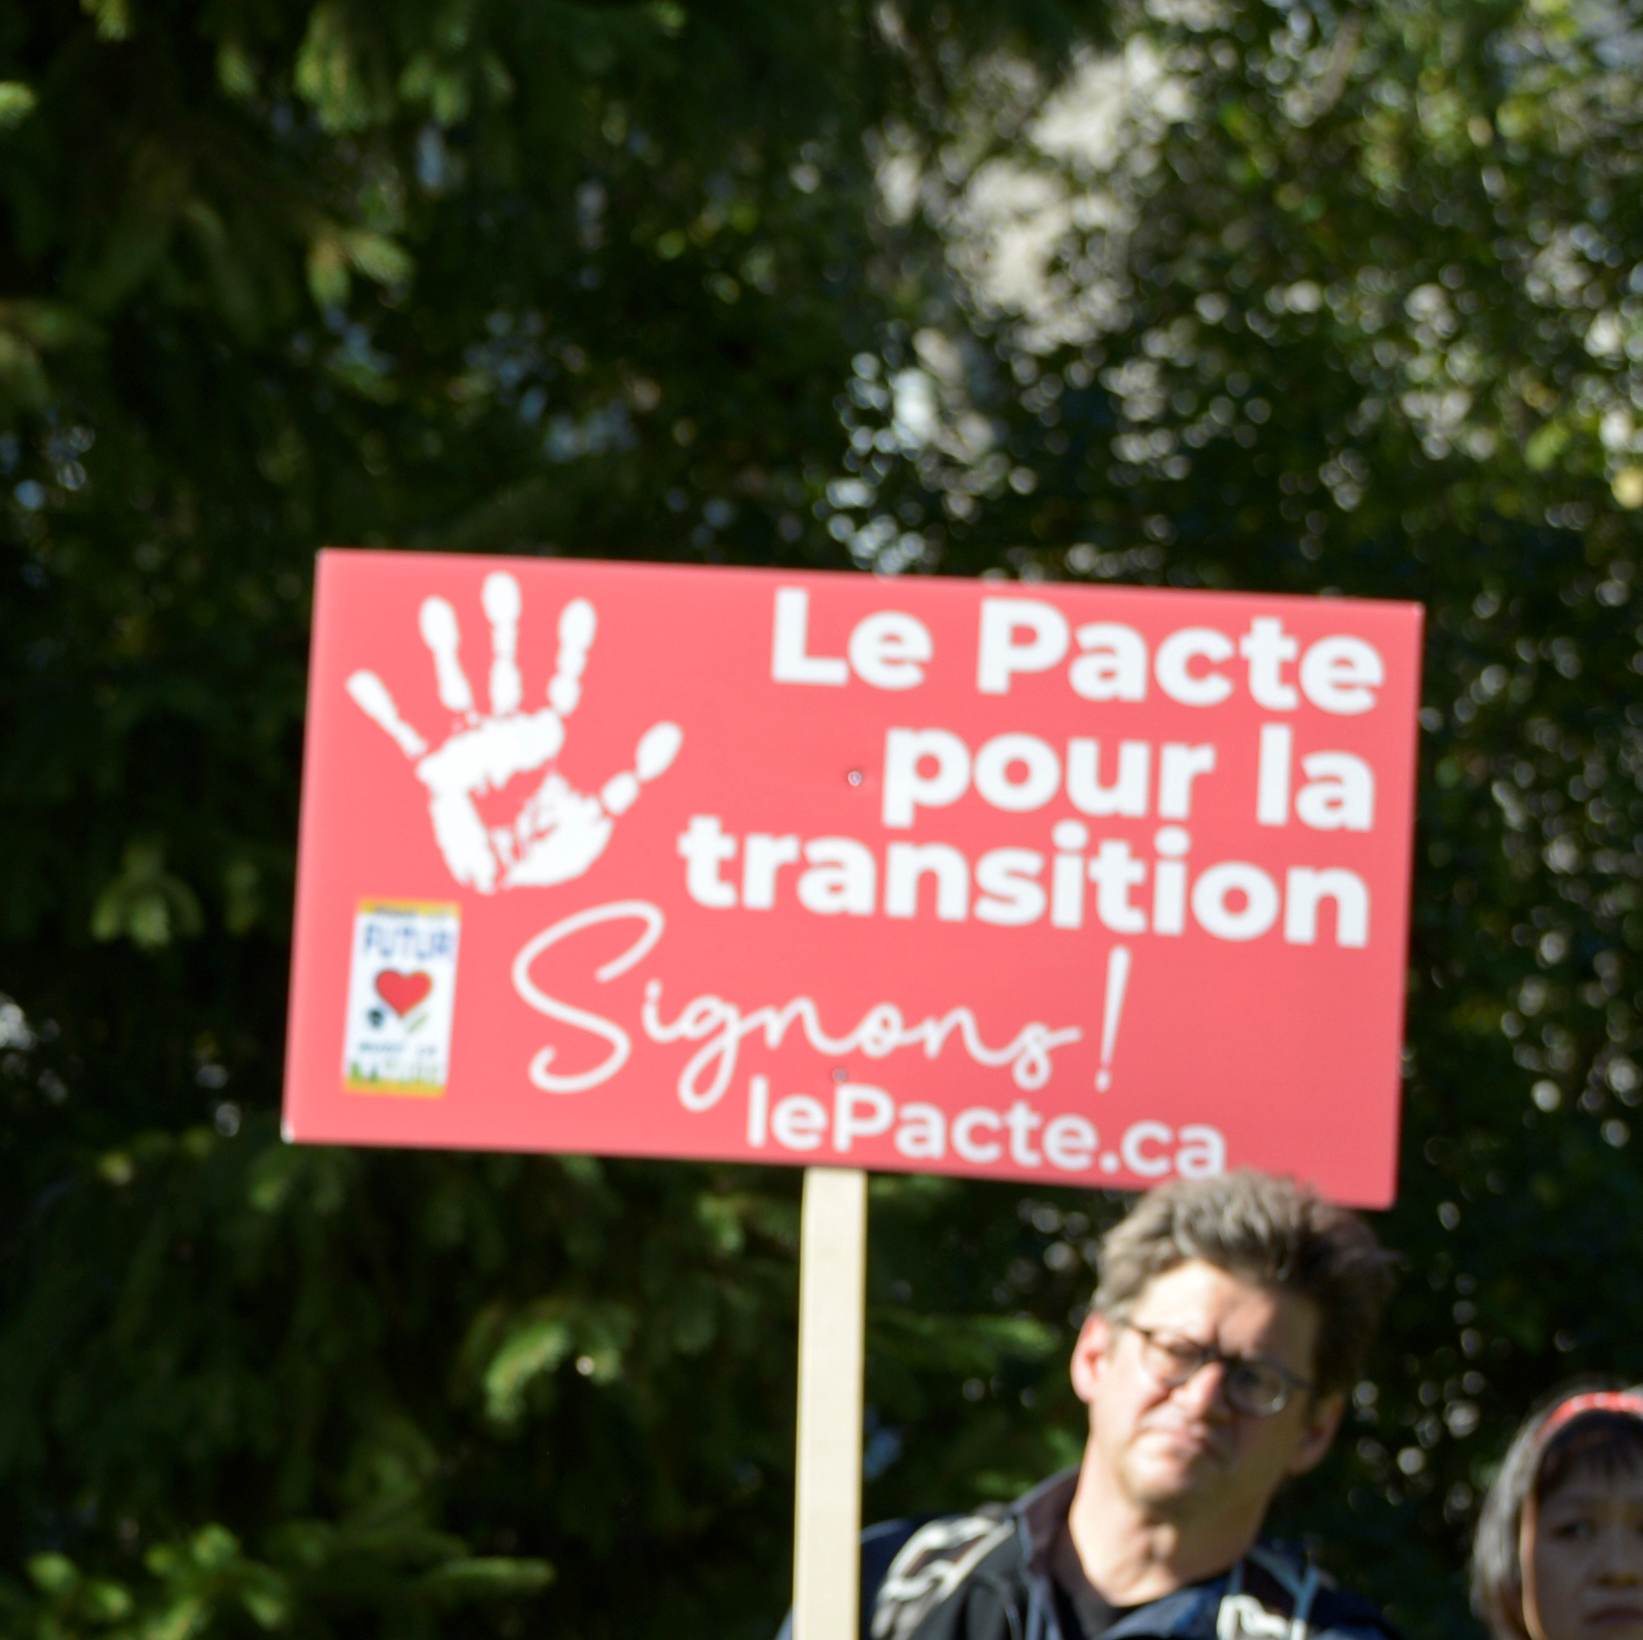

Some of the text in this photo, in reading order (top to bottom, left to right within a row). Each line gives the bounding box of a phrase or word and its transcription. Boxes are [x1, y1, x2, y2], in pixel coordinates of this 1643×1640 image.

[770, 586, 1386, 716] Le Pacte
[880, 722, 1377, 834] pour la
[676, 814, 1372, 949] transition
[511, 899, 1131, 1113] Signons!
[746, 1074, 1228, 1180] lePacte.ca
